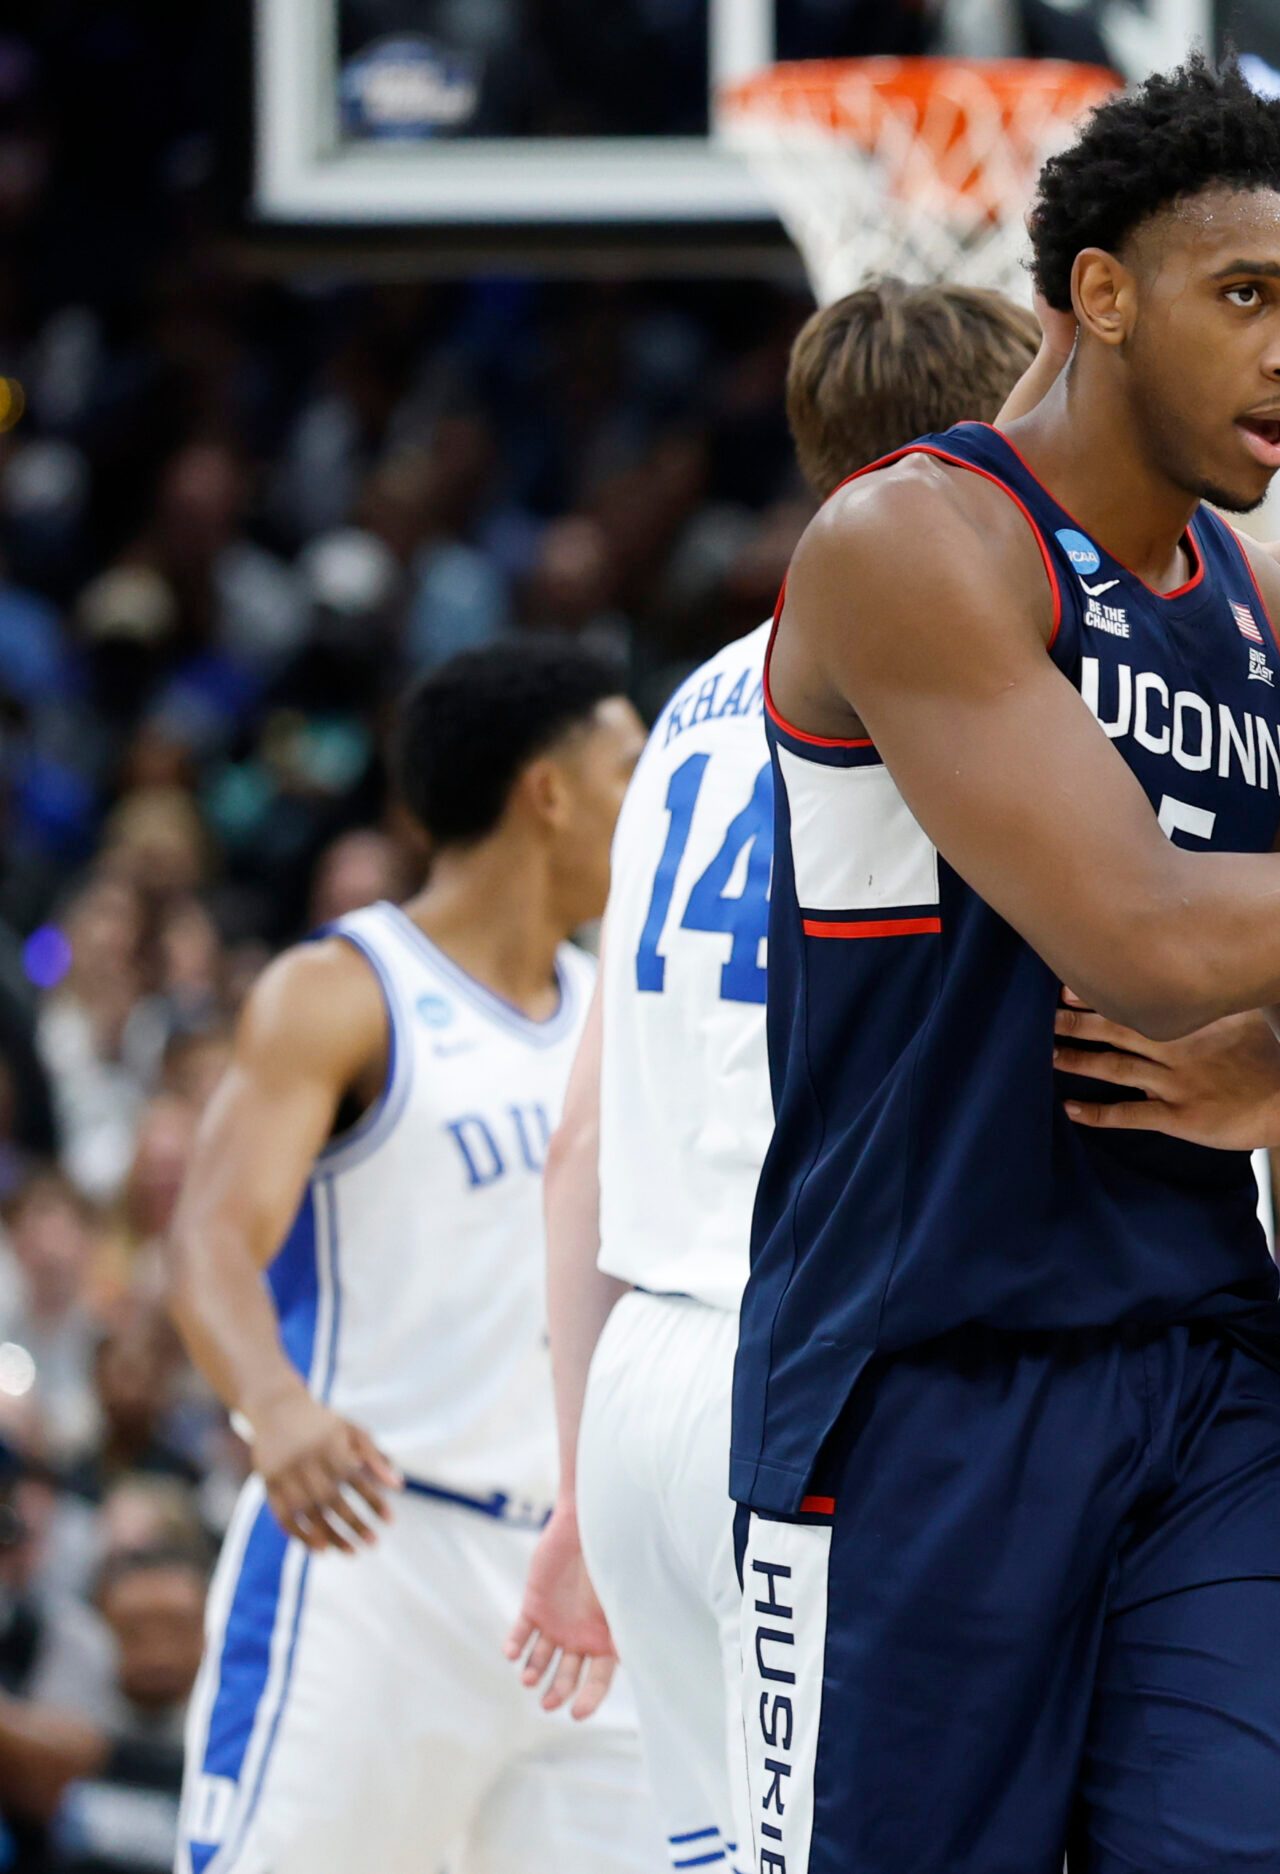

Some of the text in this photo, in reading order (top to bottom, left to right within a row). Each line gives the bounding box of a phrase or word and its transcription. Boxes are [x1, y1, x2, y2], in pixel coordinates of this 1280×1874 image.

[1088, 598, 1126, 623] BE THE
[1085, 611, 1130, 639] CHANGE
[1249, 647, 1266, 666] BIG
[1249, 660, 1274, 681] EAST
[636, 753, 774, 1005] 14
